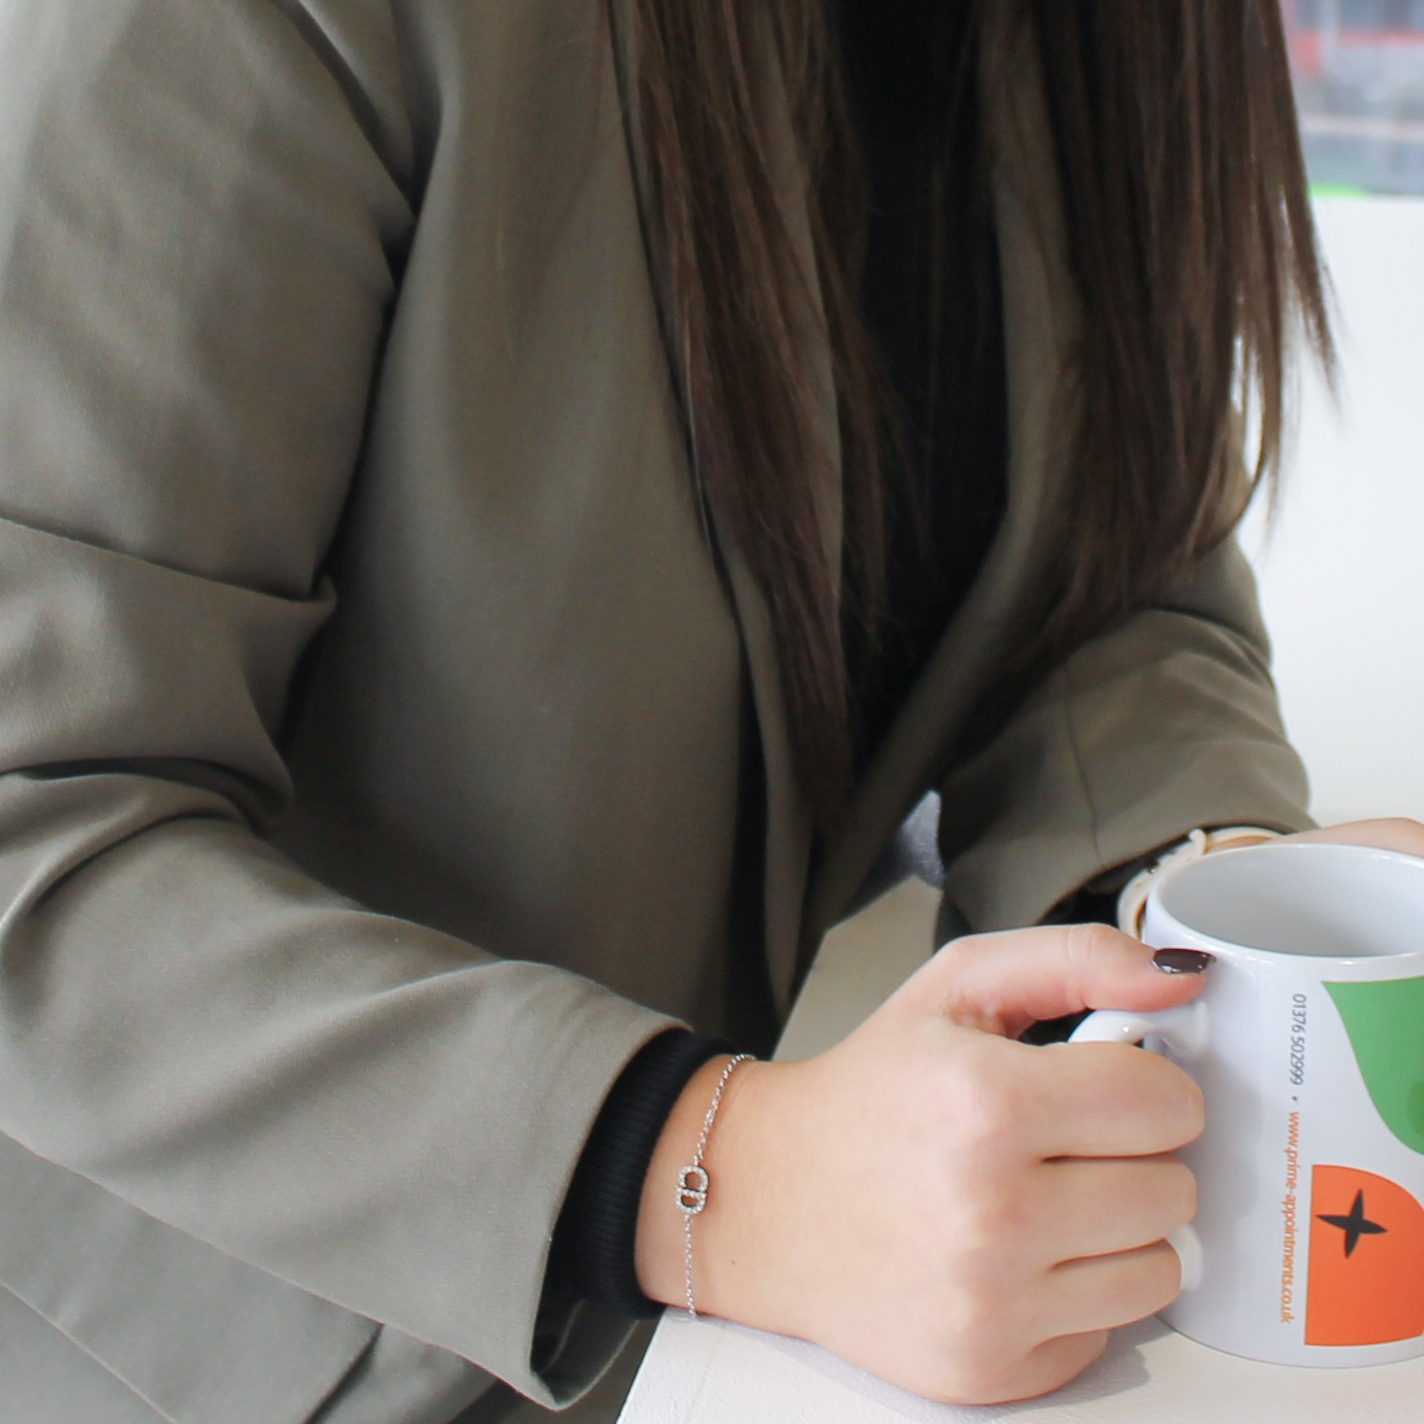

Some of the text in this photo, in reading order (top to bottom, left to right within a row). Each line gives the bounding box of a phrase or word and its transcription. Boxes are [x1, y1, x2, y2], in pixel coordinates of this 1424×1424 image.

[1280, 993, 1307, 1324] 01376 502999 www.prime-appointments.co.uk
